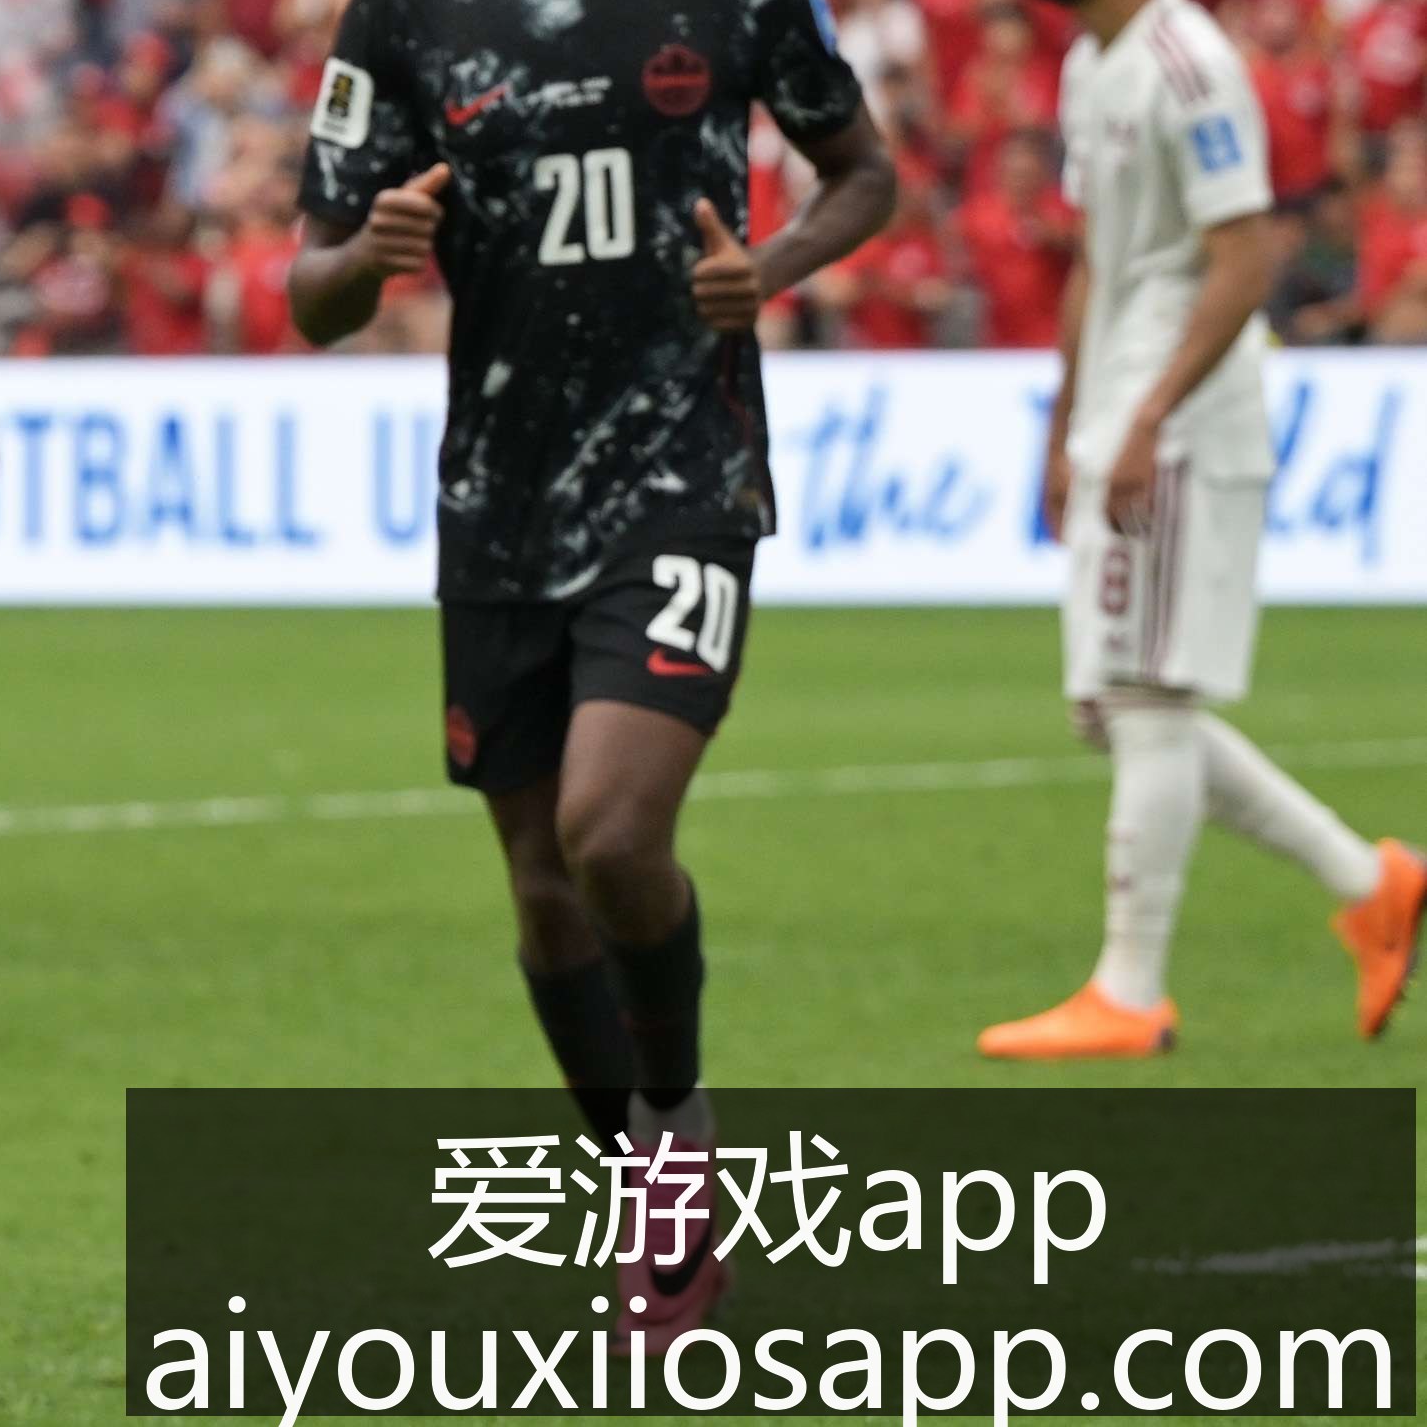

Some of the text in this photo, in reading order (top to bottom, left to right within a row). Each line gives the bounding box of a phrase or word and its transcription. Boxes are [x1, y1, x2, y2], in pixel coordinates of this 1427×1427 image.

[534, 147, 635, 265] 20
[785, 384, 990, 554] the
[646, 554, 739, 673] 20
